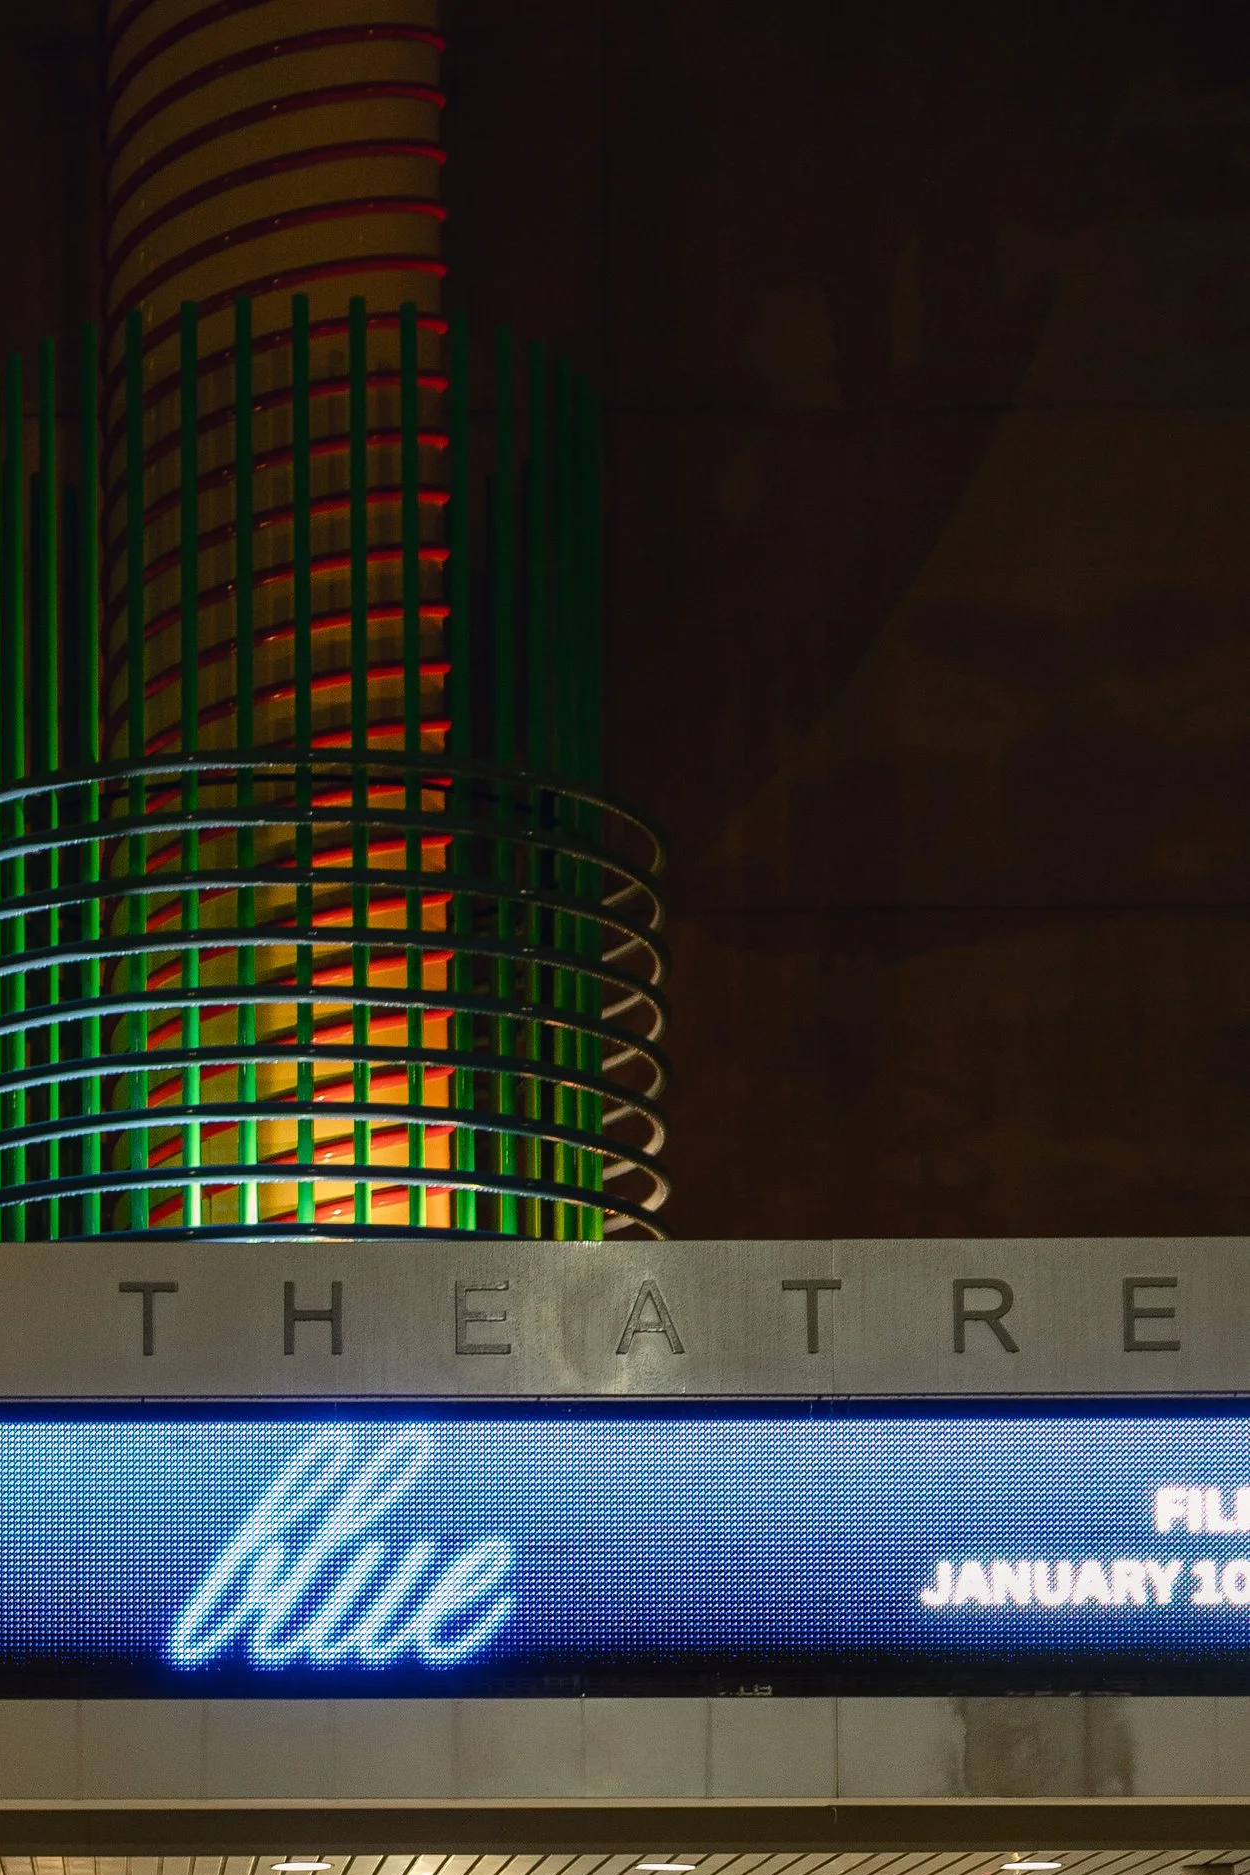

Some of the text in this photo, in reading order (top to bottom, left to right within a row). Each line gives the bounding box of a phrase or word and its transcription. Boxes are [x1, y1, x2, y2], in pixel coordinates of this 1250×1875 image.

[119, 1277, 1181, 1355] THEATRE
[161, 1424, 518, 1670] blue
[919, 1558, 1250, 1605] JANUARY 10
